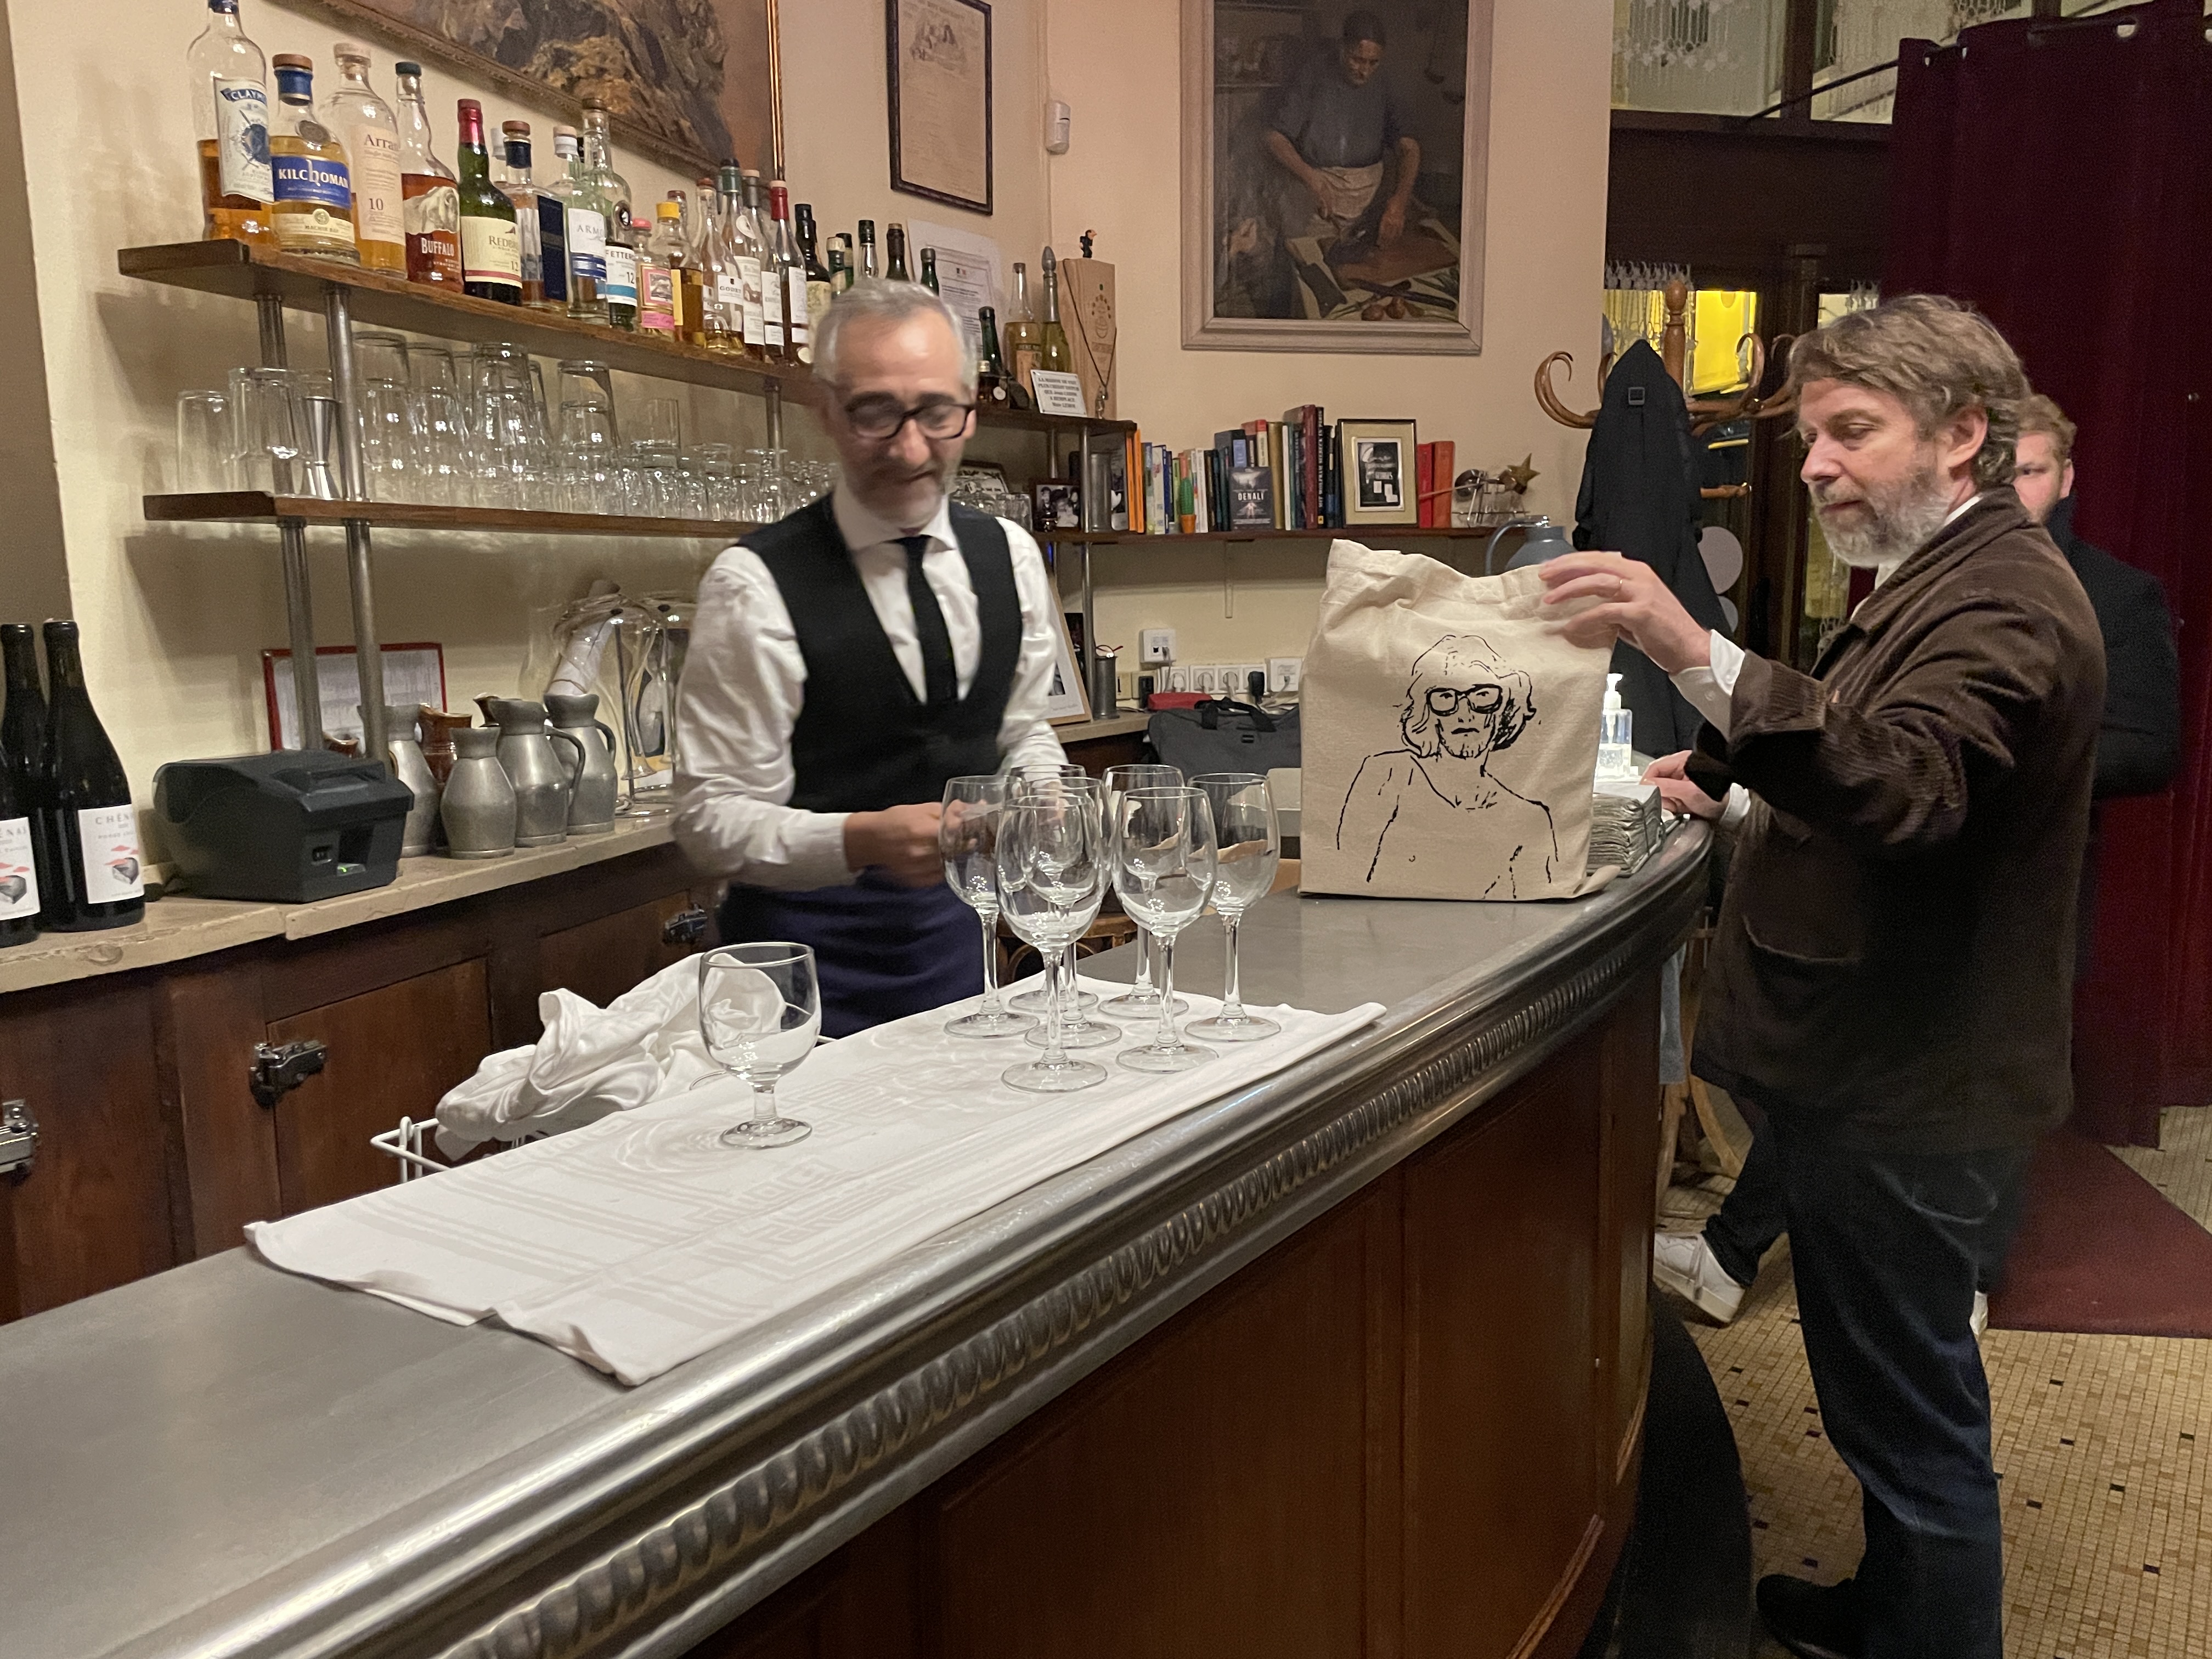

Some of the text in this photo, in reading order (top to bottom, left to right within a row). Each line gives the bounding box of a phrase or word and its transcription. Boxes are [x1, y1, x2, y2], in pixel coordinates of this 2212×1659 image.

[369, 198, 383, 210] 10
[421, 238, 454, 257] BUFFALO
[511, 261, 518, 272] 12
[627, 272, 635, 284] 12
[1238, 492, 1264, 501] DENALI
